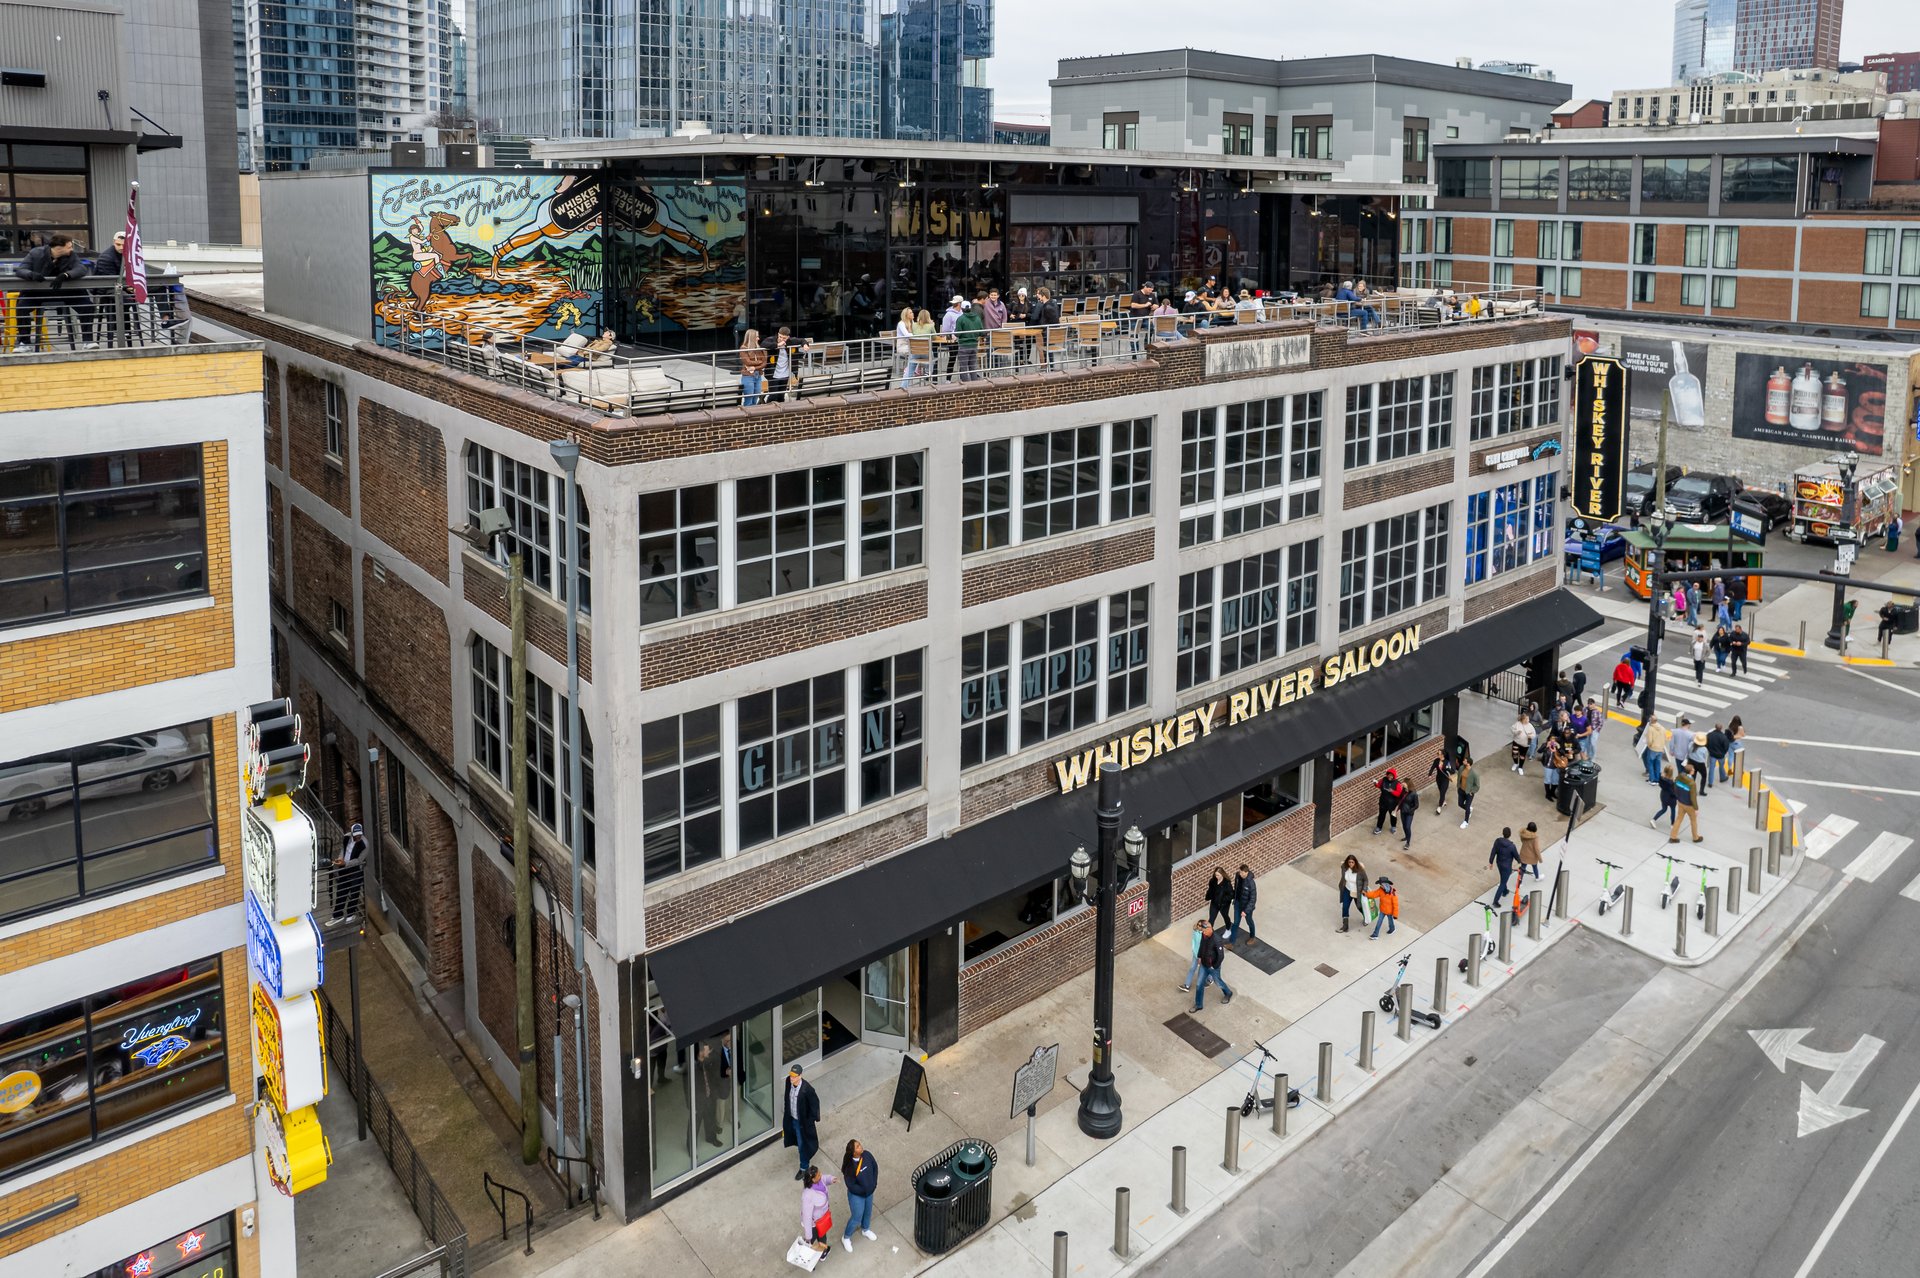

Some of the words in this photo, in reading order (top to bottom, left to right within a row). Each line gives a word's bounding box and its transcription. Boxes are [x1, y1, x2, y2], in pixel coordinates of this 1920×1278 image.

[444, 184, 482, 210] my
[465, 176, 536, 227] mind
[554, 183, 600, 216] WHISKEY
[567, 197, 599, 220] RIVER
[1626, 358, 1646, 366] WHEN
[1646, 360, 1669, 369] YOU'RE
[1630, 365, 1649, 373] AVING
[1650, 366, 1667, 375] RUM.
[1642, 354, 1660, 362] FLIES
[1591, 362, 1611, 449] WHISKEY
[1753, 427, 1782, 436] AMERICAN
[1588, 452, 1605, 516] RIVER
[1055, 700, 1218, 794] WHISKEY
[1229, 666, 1315, 726] RIVER
[1323, 624, 1422, 688] SALOON
[742, 707, 885, 791] GLEN
[1129, 899, 1143, 915] FDC
[121, 1007, 201, 1049] Yuengling
